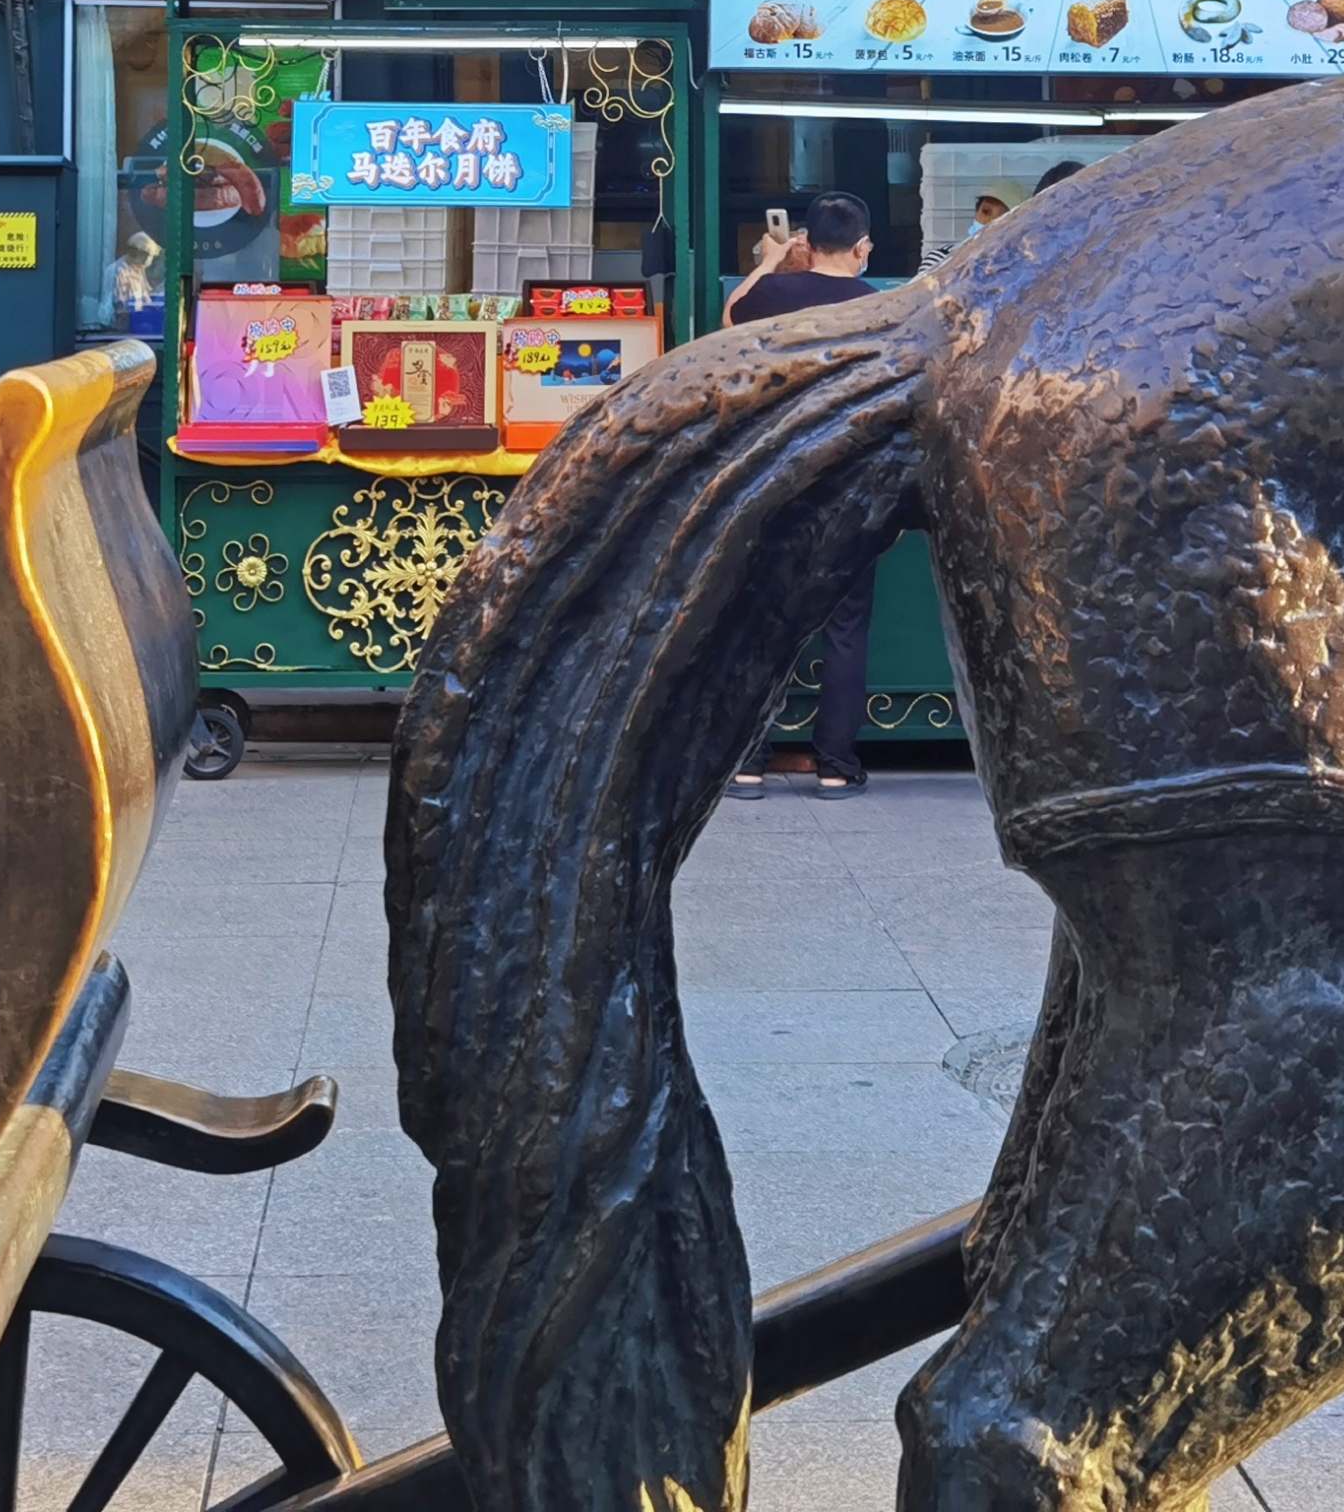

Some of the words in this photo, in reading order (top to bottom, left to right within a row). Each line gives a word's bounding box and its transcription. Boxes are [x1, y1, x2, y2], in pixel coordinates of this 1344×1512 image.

[952, 51, 986, 63] 油茶面
[1059, 52, 1092, 64] 肉松卷
[1172, 53, 1194, 64] 粉肠
[1290, 53, 1313, 65] 小肚
[365, 115, 504, 156] 百年食府
[346, 150, 522, 191] 马迭尔月饼
